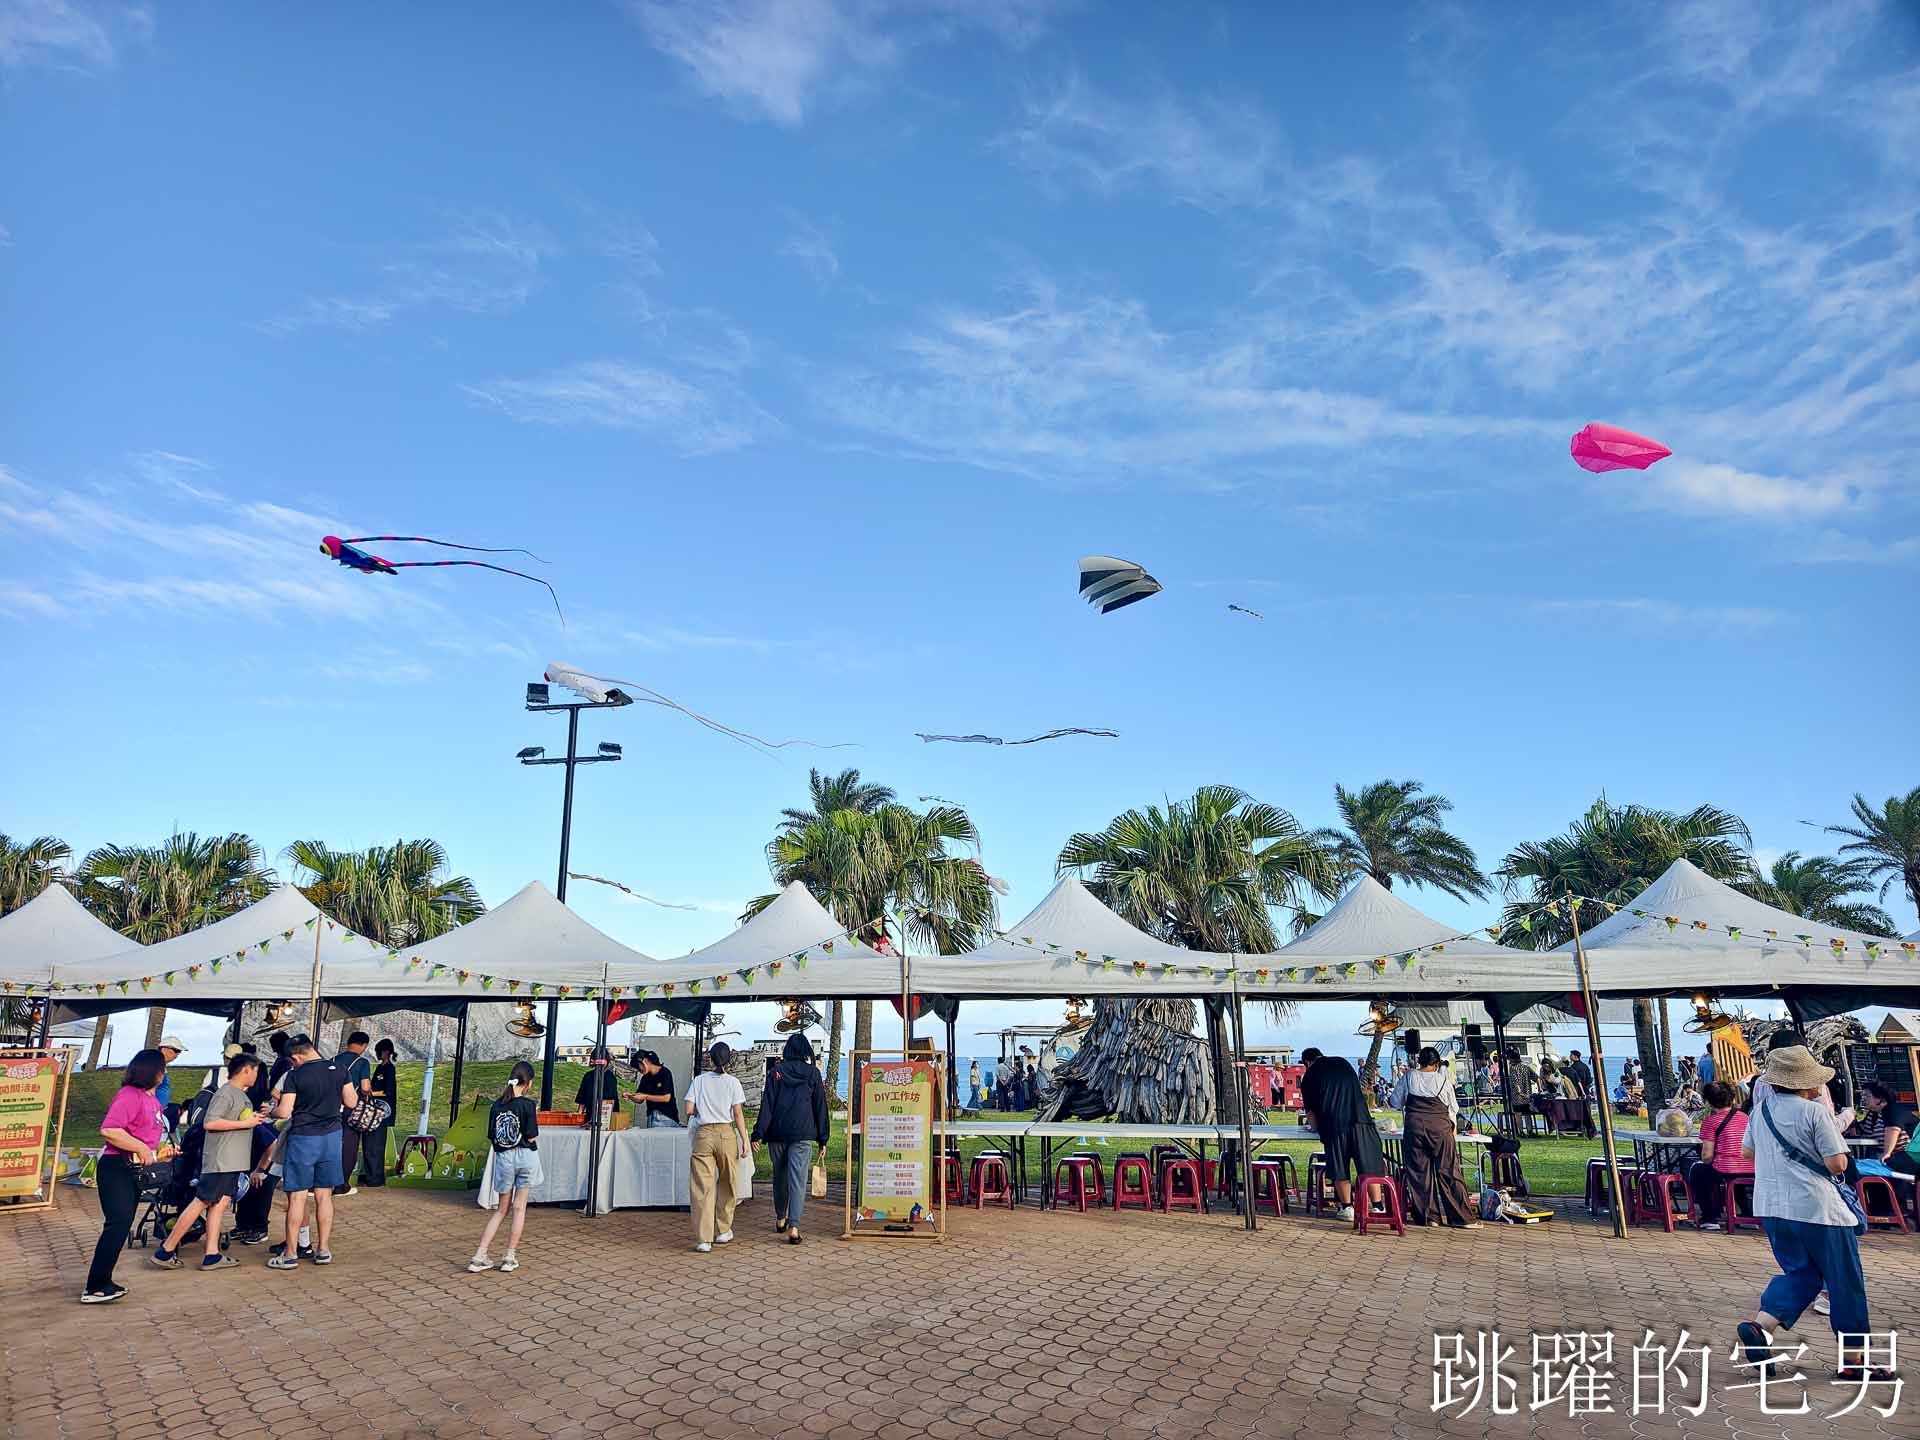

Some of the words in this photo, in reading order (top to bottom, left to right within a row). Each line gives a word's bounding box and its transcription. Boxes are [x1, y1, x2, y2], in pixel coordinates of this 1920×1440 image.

[874, 1091, 920, 1103] DIY工作坊
[407, 1163, 415, 1174] 6
[442, 1165, 450, 1176] 3
